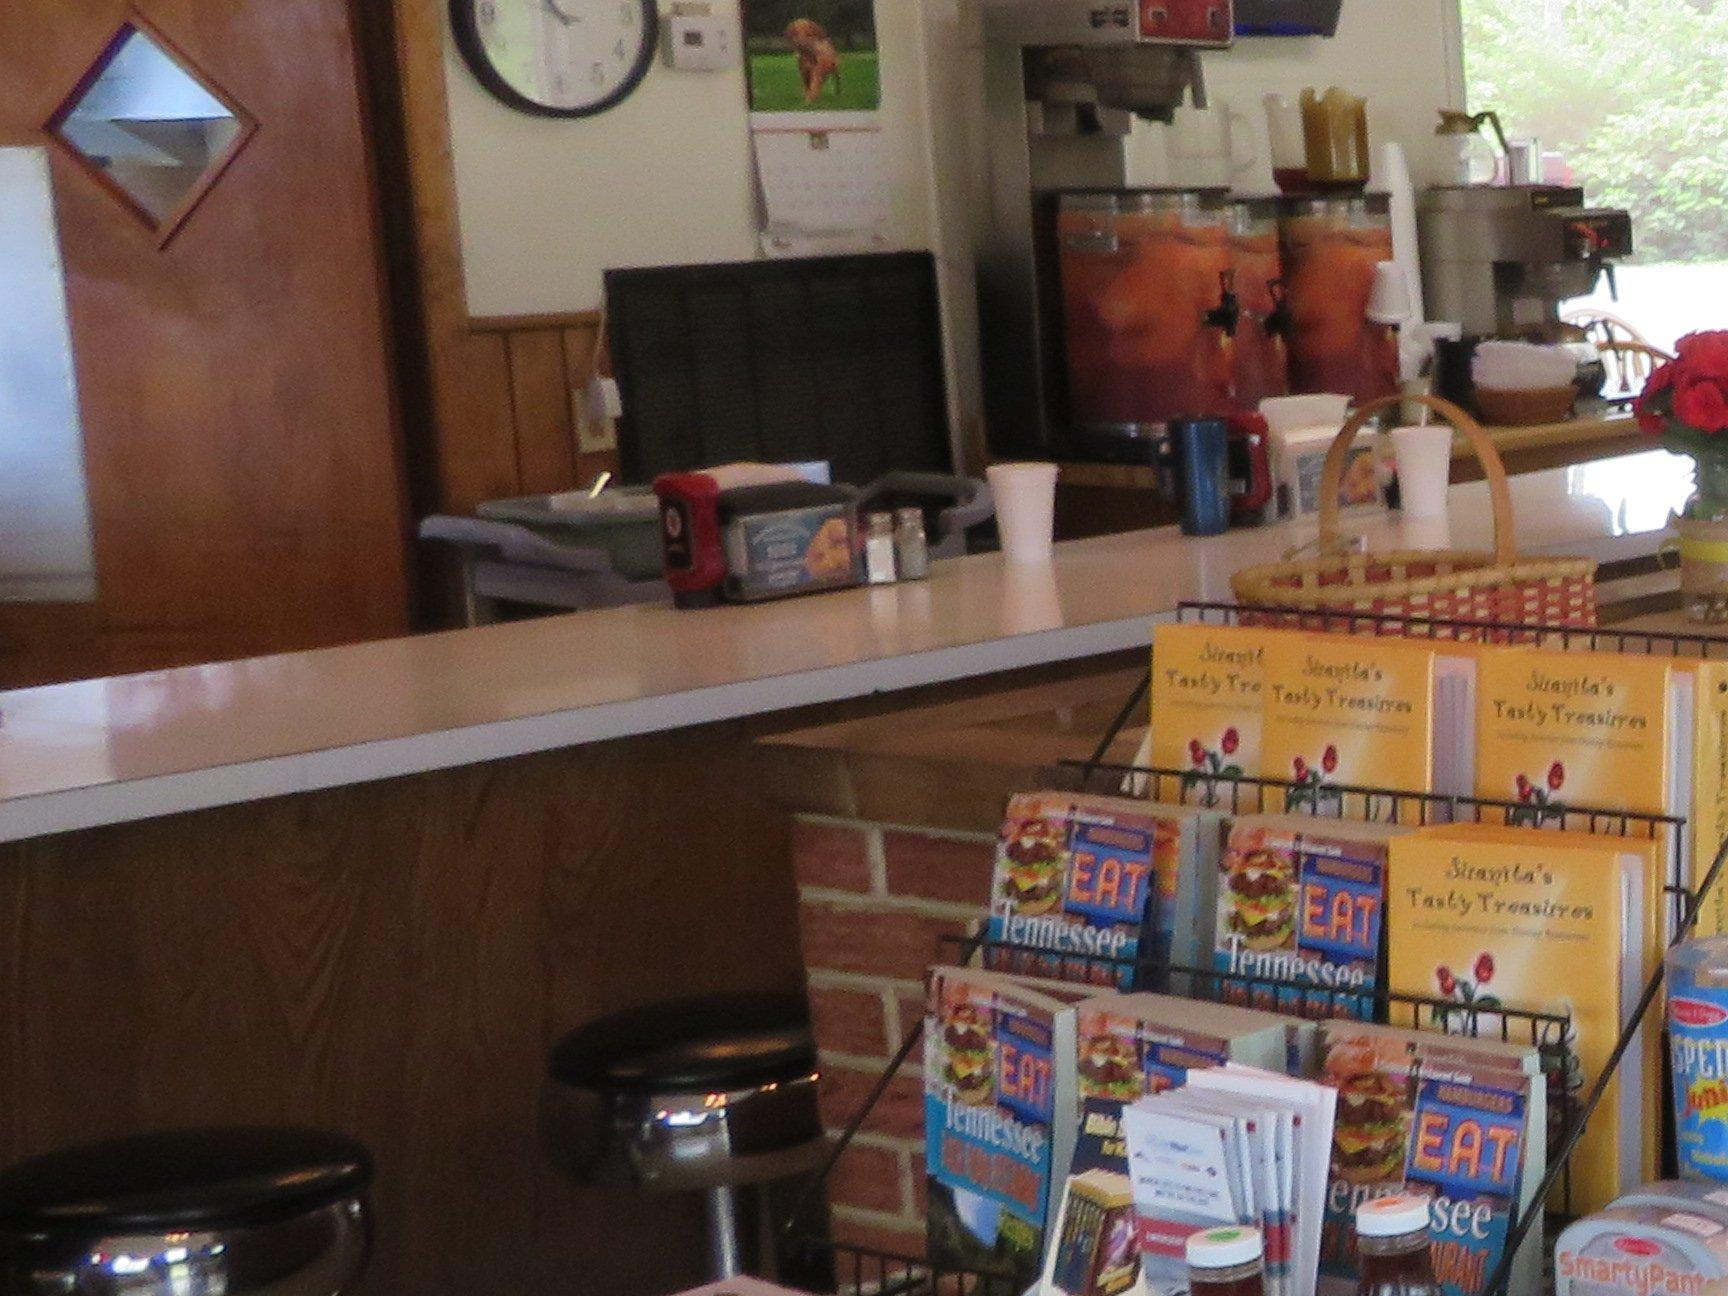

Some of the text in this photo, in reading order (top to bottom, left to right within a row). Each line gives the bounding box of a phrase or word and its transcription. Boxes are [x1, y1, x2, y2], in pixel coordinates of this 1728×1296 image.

[1493, 699, 1548, 726] Tasty
[1071, 852, 1149, 912] EAT
[1406, 886, 1474, 917] Tasty
[999, 898, 1129, 958] Tennessee
[1303, 883, 1377, 945] EAT
[1226, 934, 1365, 987] Tennessee
[1001, 1043, 1050, 1104] EAT
[1414, 1111, 1518, 1183] EAT
